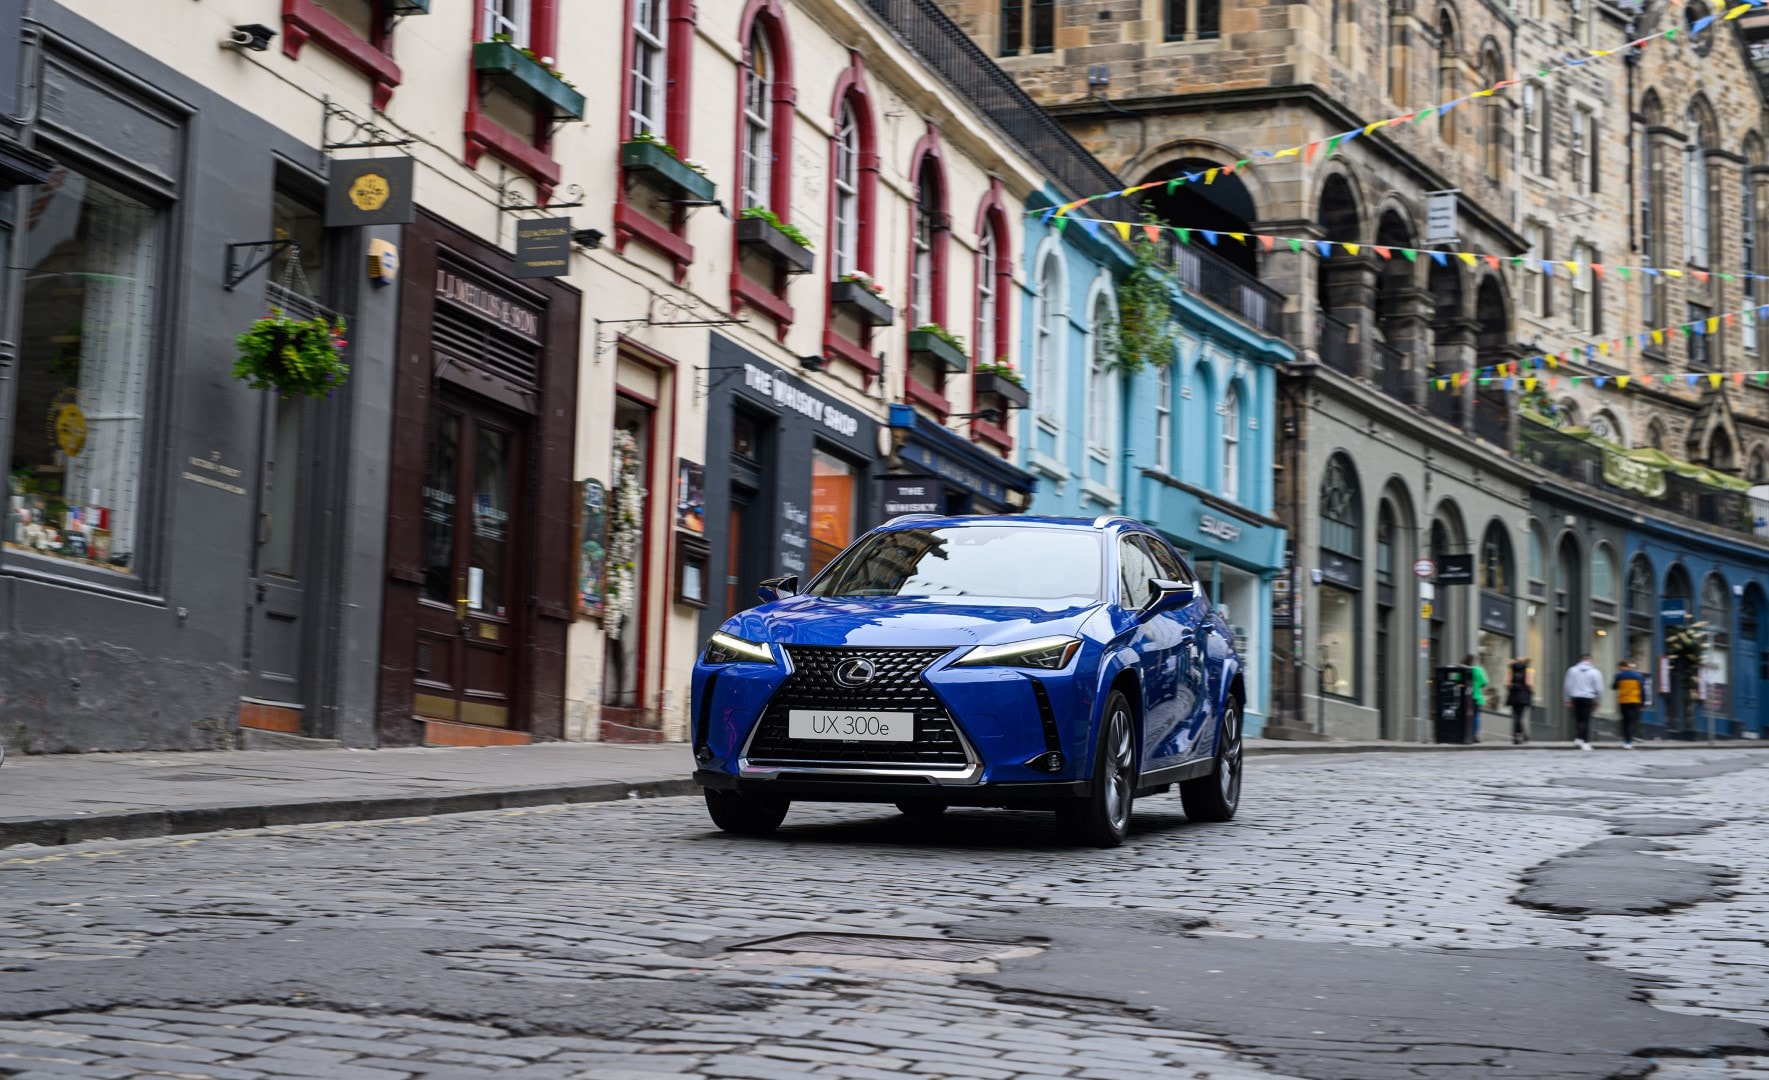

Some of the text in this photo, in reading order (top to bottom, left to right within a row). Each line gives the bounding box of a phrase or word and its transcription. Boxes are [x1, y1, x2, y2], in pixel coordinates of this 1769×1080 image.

[743, 362, 858, 437] THE WHISKY SHOP
[897, 486, 925, 496] THE
[885, 502, 937, 513] WHISKY
[812, 715, 890, 736] UX 300e
